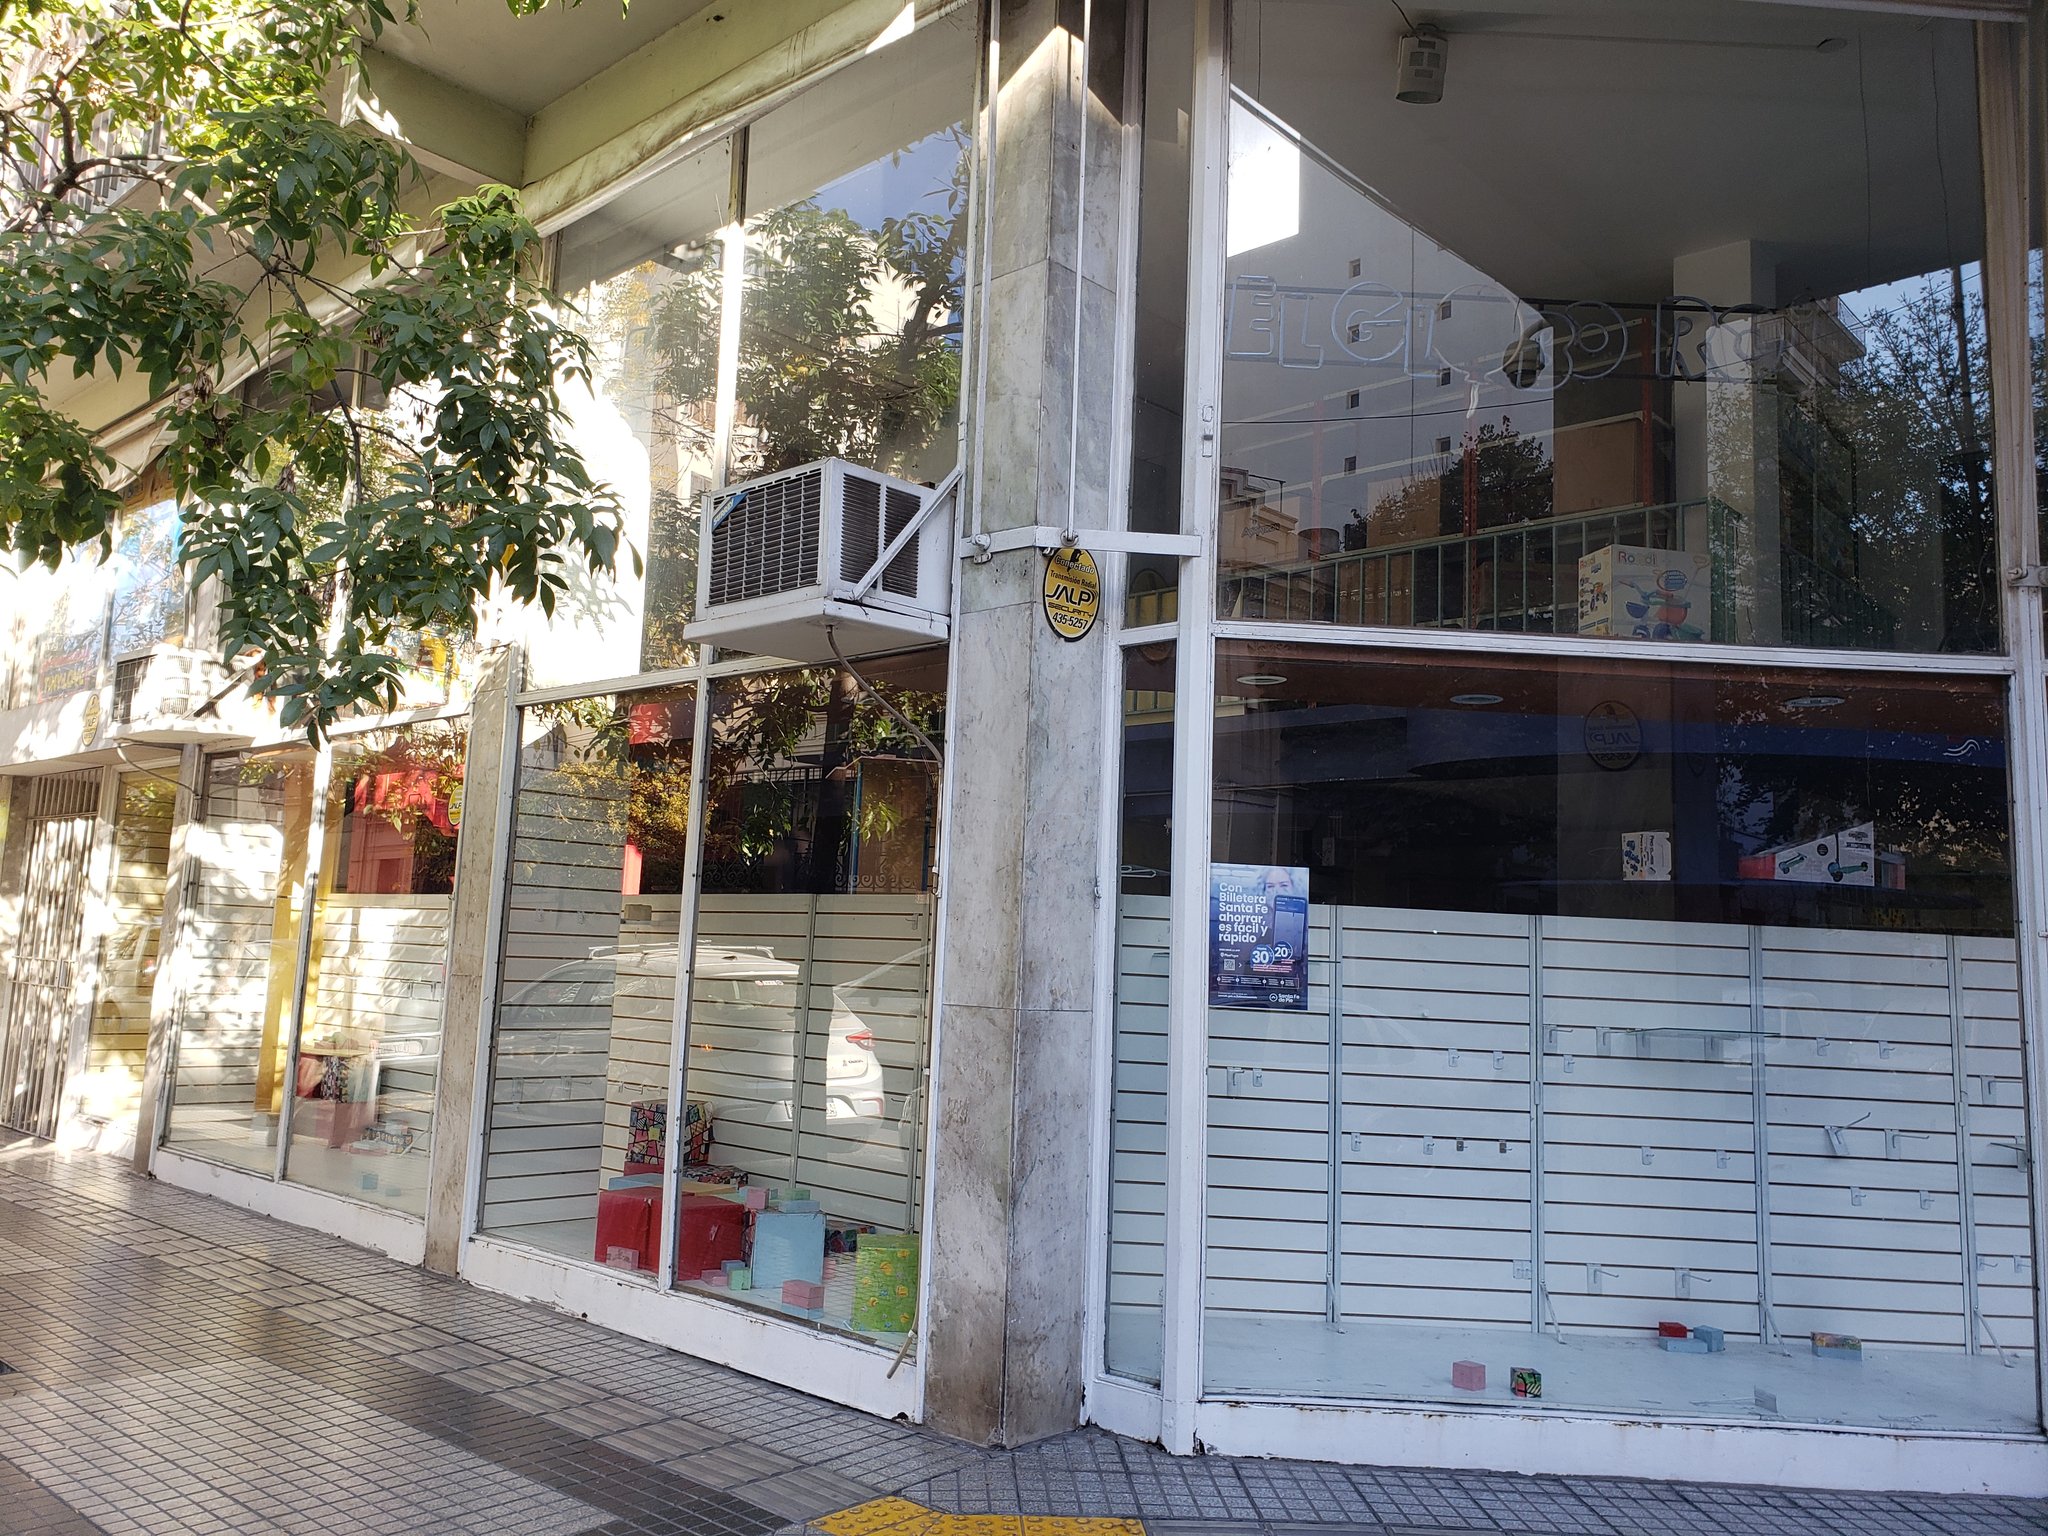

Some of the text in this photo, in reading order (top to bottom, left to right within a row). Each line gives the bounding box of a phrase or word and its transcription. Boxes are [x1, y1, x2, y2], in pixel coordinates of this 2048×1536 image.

[1055, 555, 1096, 574] Conectado
[1050, 570, 1097, 589] Transmisión Radial
[1046, 584, 1093, 606] JALP
[1047, 602, 1094, 619] SECURITY
[1052, 612, 1089, 630] 435-5257
[1219, 882, 1242, 893] Con
[1219, 892, 1267, 904] Billetera
[1219, 902, 1268, 914] Santa Fe
[1219, 912, 1266, 925] ahorrar,
[1219, 922, 1268, 936] es fácil y
[1219, 930, 1257, 945] rápido
